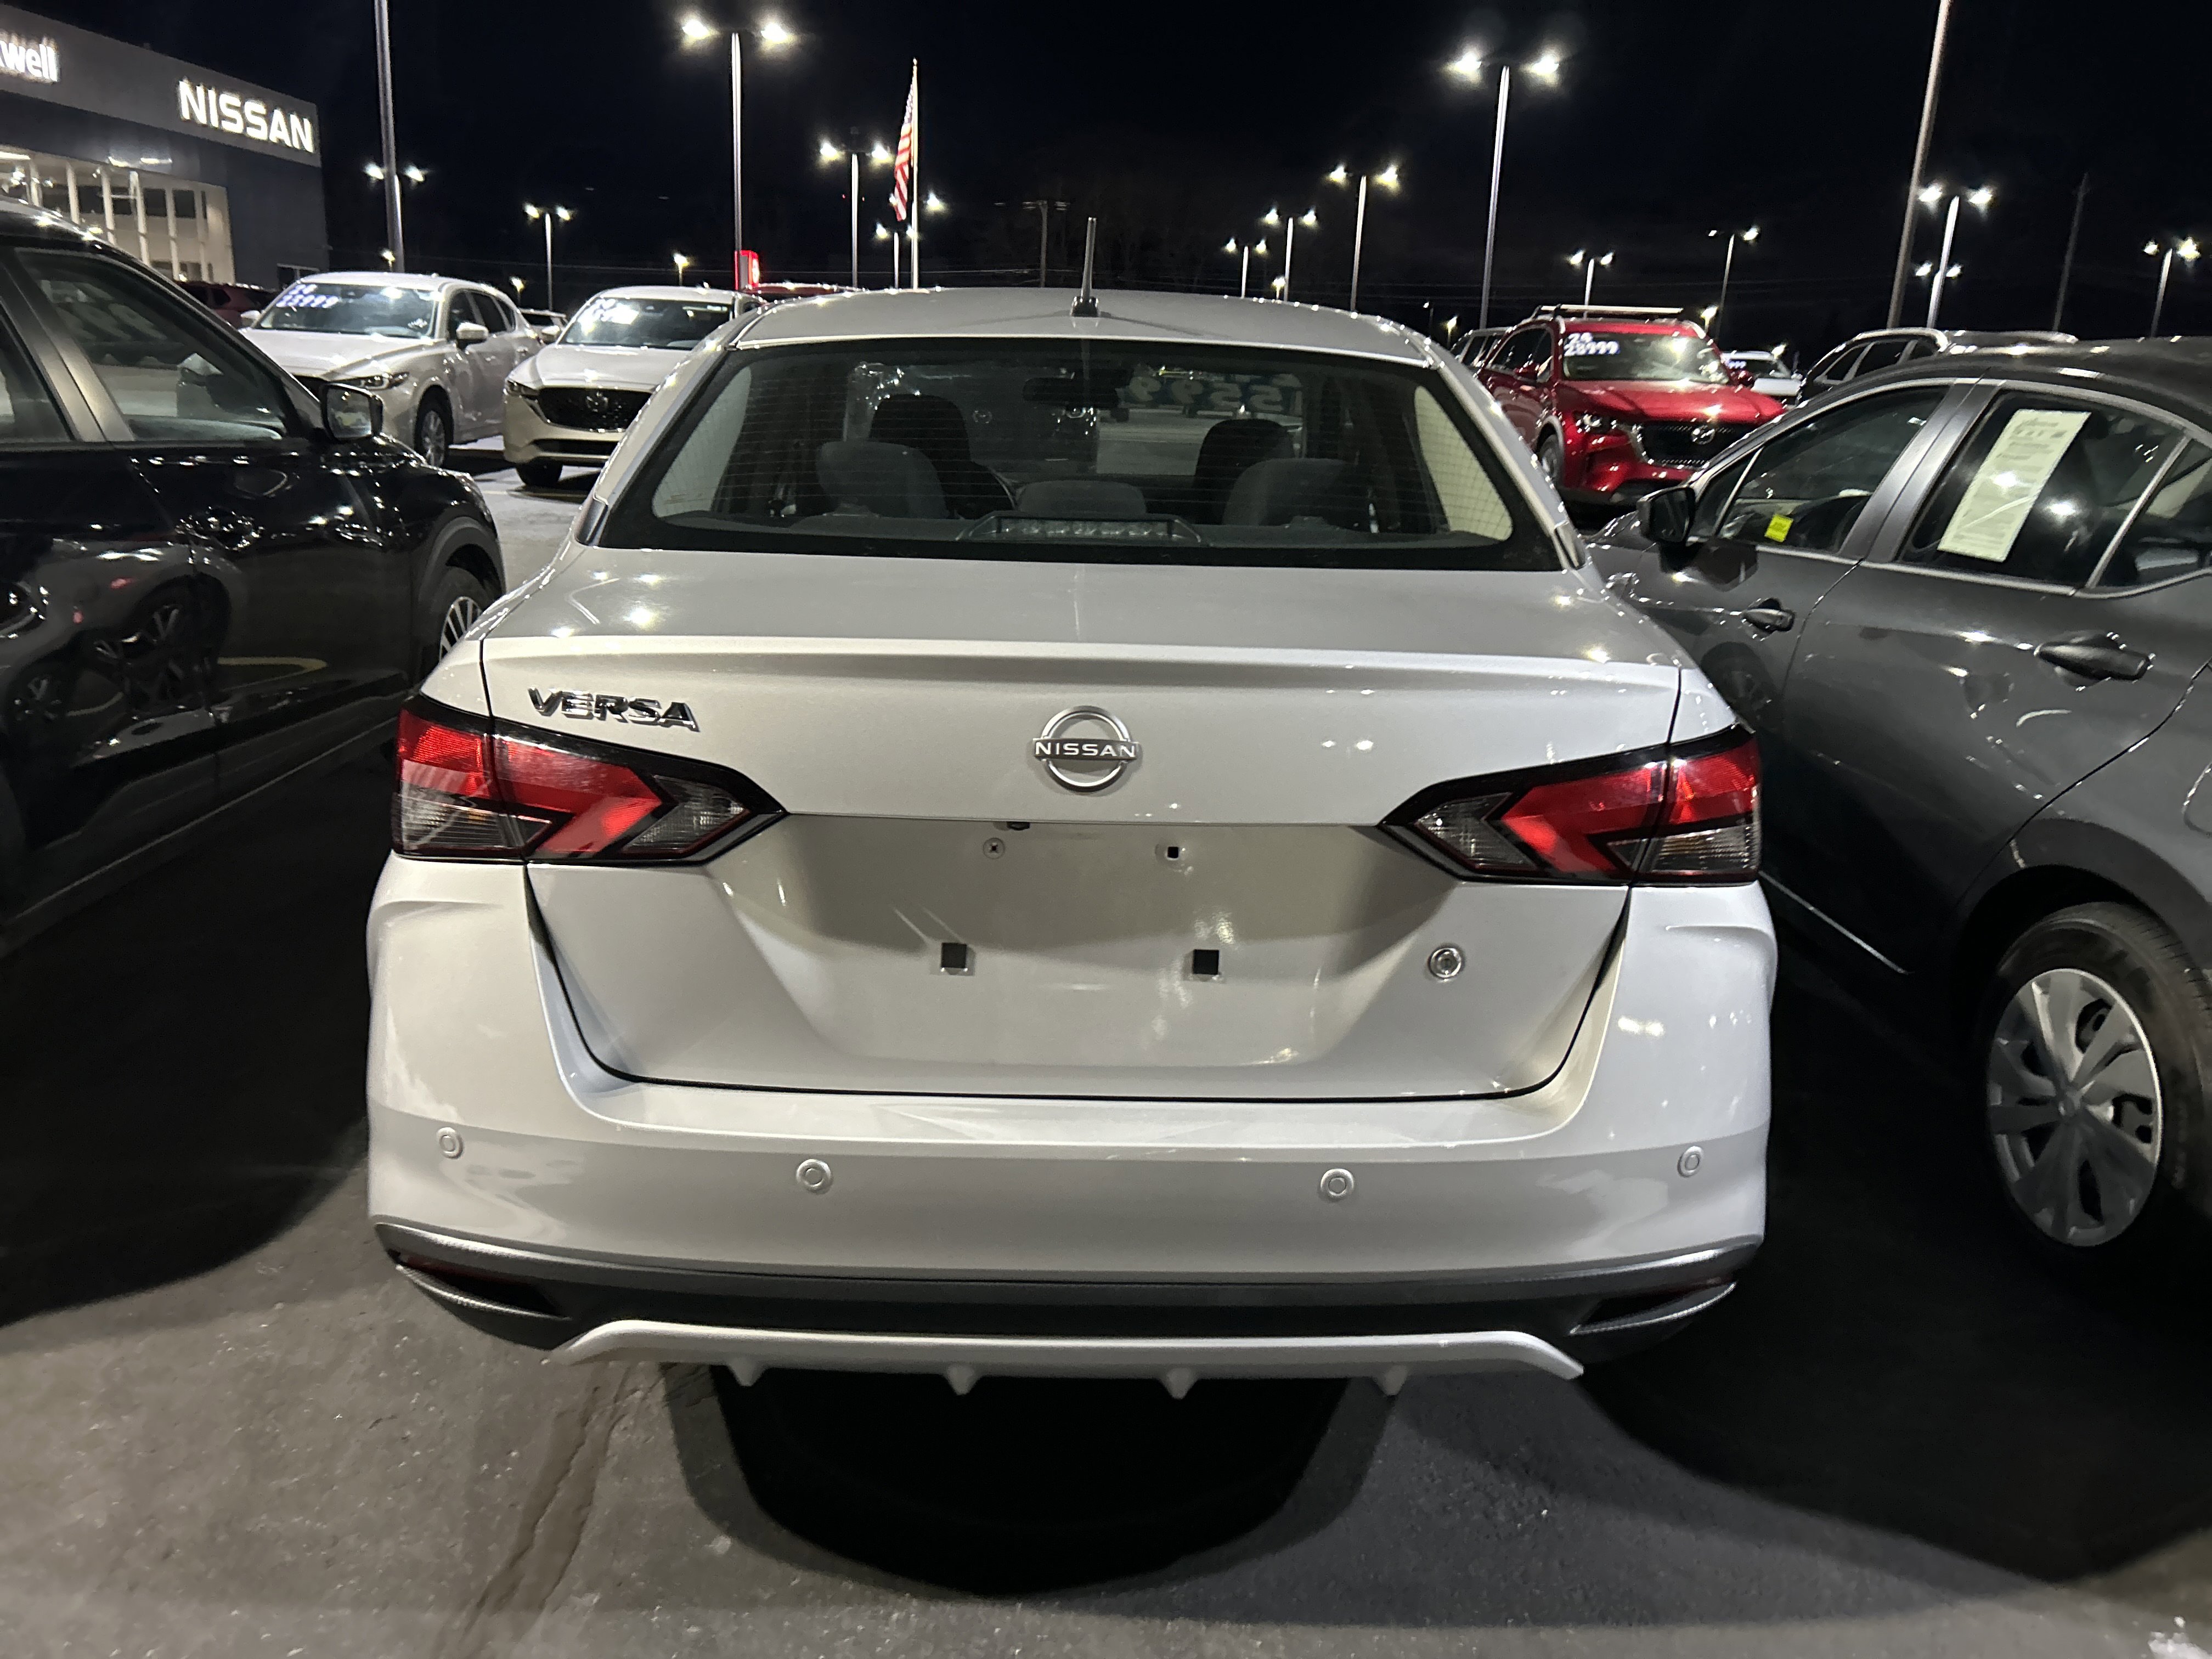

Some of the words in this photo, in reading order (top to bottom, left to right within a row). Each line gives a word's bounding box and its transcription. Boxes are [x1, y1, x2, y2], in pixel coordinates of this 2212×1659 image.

[0, 40, 58, 82] well
[179, 80, 315, 154] NISSAN
[527, 685, 701, 732] VERSA
[1035, 741, 1136, 758] NISSAN
